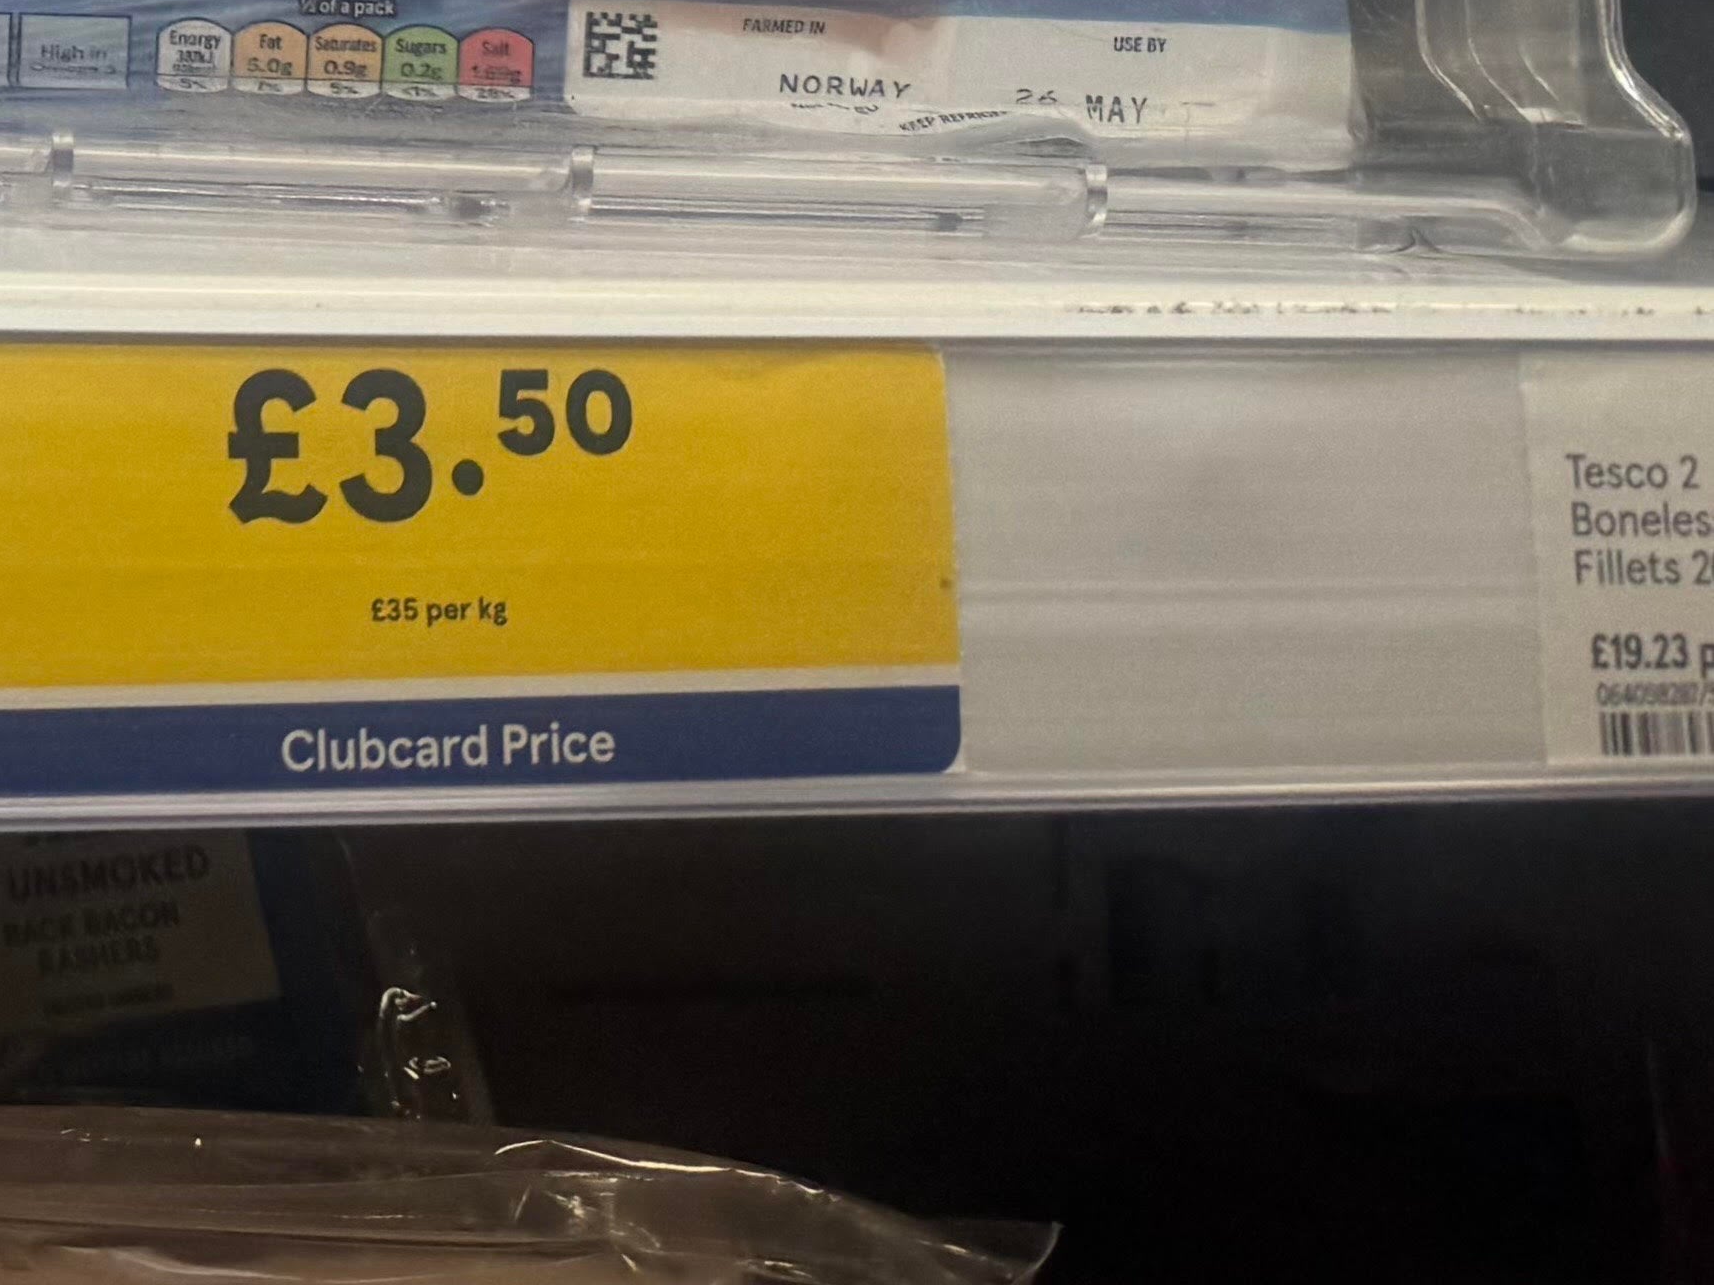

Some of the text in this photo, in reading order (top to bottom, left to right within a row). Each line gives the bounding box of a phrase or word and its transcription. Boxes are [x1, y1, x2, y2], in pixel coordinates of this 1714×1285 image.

[341, 1, 350, 14] a
[354, 0, 395, 16] pack
[743, 18, 825, 34] FARMED IN
[170, 31, 221, 49] Energy
[260, 34, 283, 51] Fat
[395, 38, 447, 56] Sugars
[1114, 37, 1167, 53] USE BY
[780, 74, 910, 98] NORWAY
[1085, 94, 1148, 124] MAY
[227, 367, 634, 524] £3.50
[1565, 453, 1700, 489] Tesco 2
[1575, 547, 1681, 585] Fillets
[371, 595, 508, 627] £35 per kg
[1592, 633, 1689, 670] £19.23
[281, 720, 616, 771] Clubcard Price
